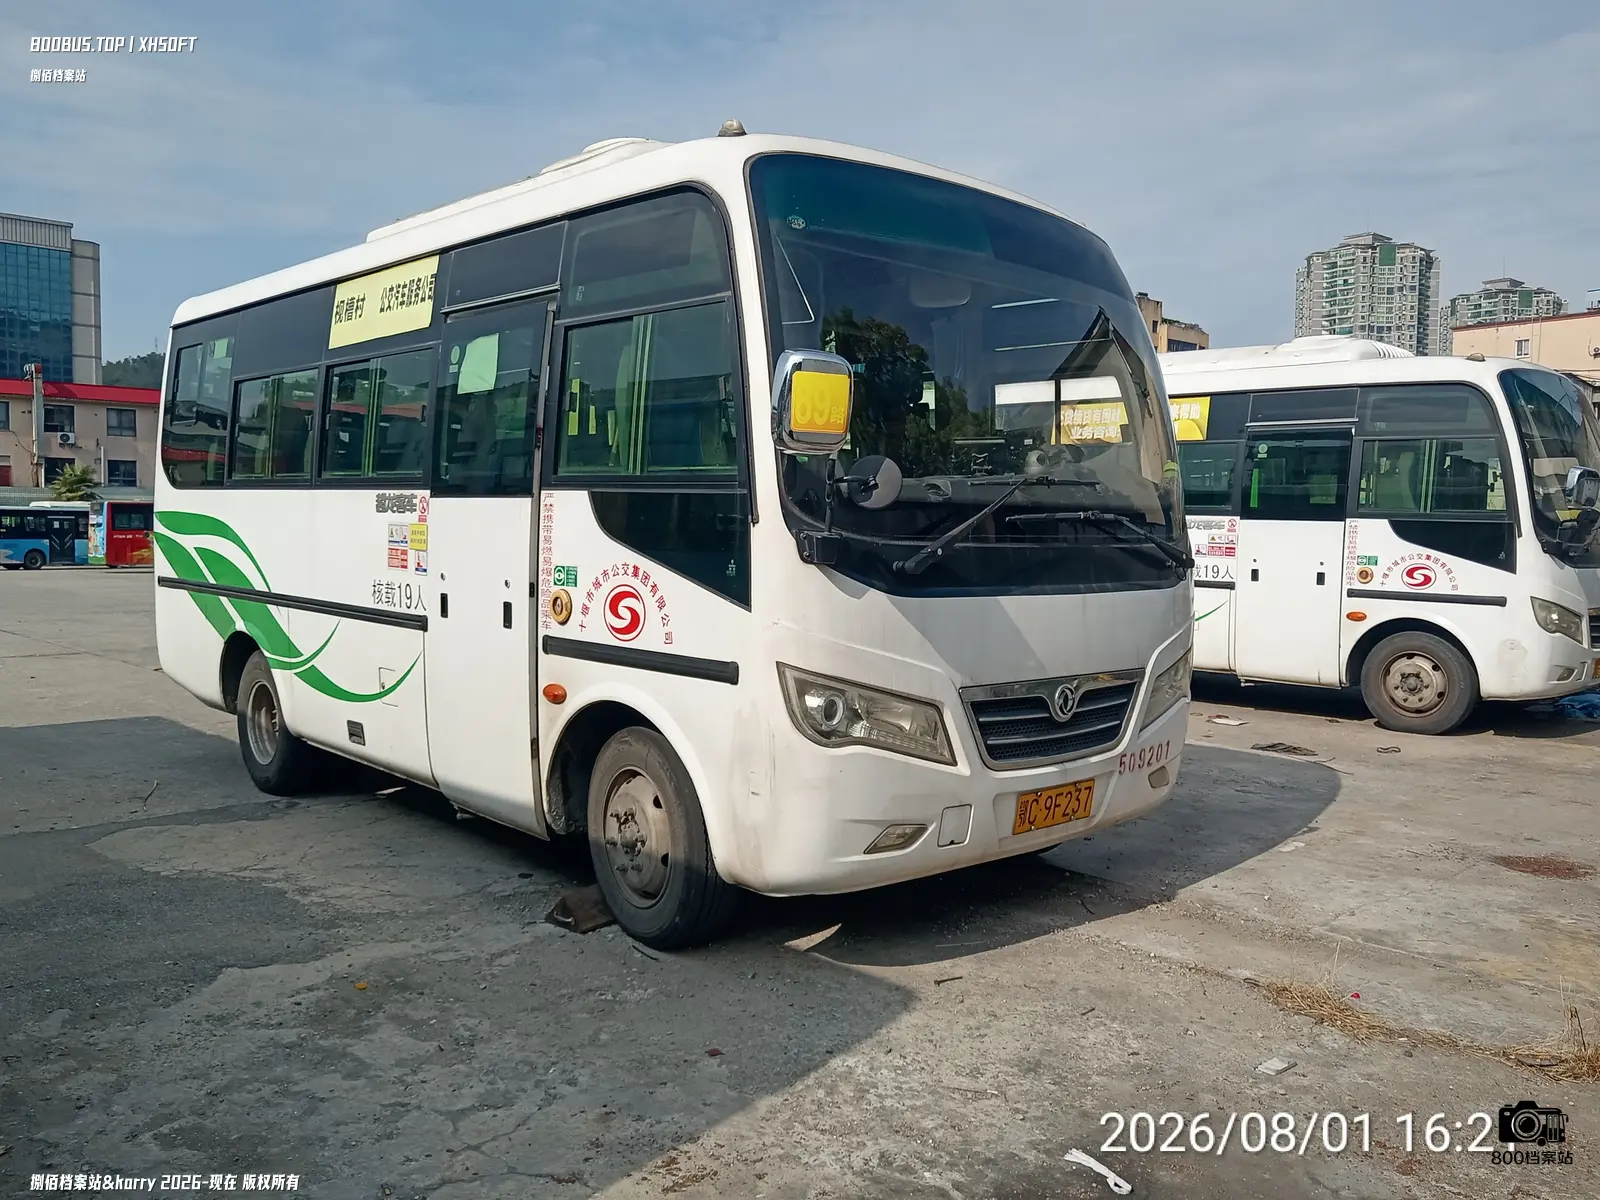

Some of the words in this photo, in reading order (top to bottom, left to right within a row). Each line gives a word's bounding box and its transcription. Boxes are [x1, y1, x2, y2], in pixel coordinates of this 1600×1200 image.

[379, 273, 437, 314] 公交汽车服务公司
[541, 492, 555, 631] 严禁携带易燃易爆危险品乘车
[371, 579, 428, 612] 核载19人
[578, 562, 674, 645] 十堰市城市公交集团有限公司
[1118, 739, 1171, 776] 509201
